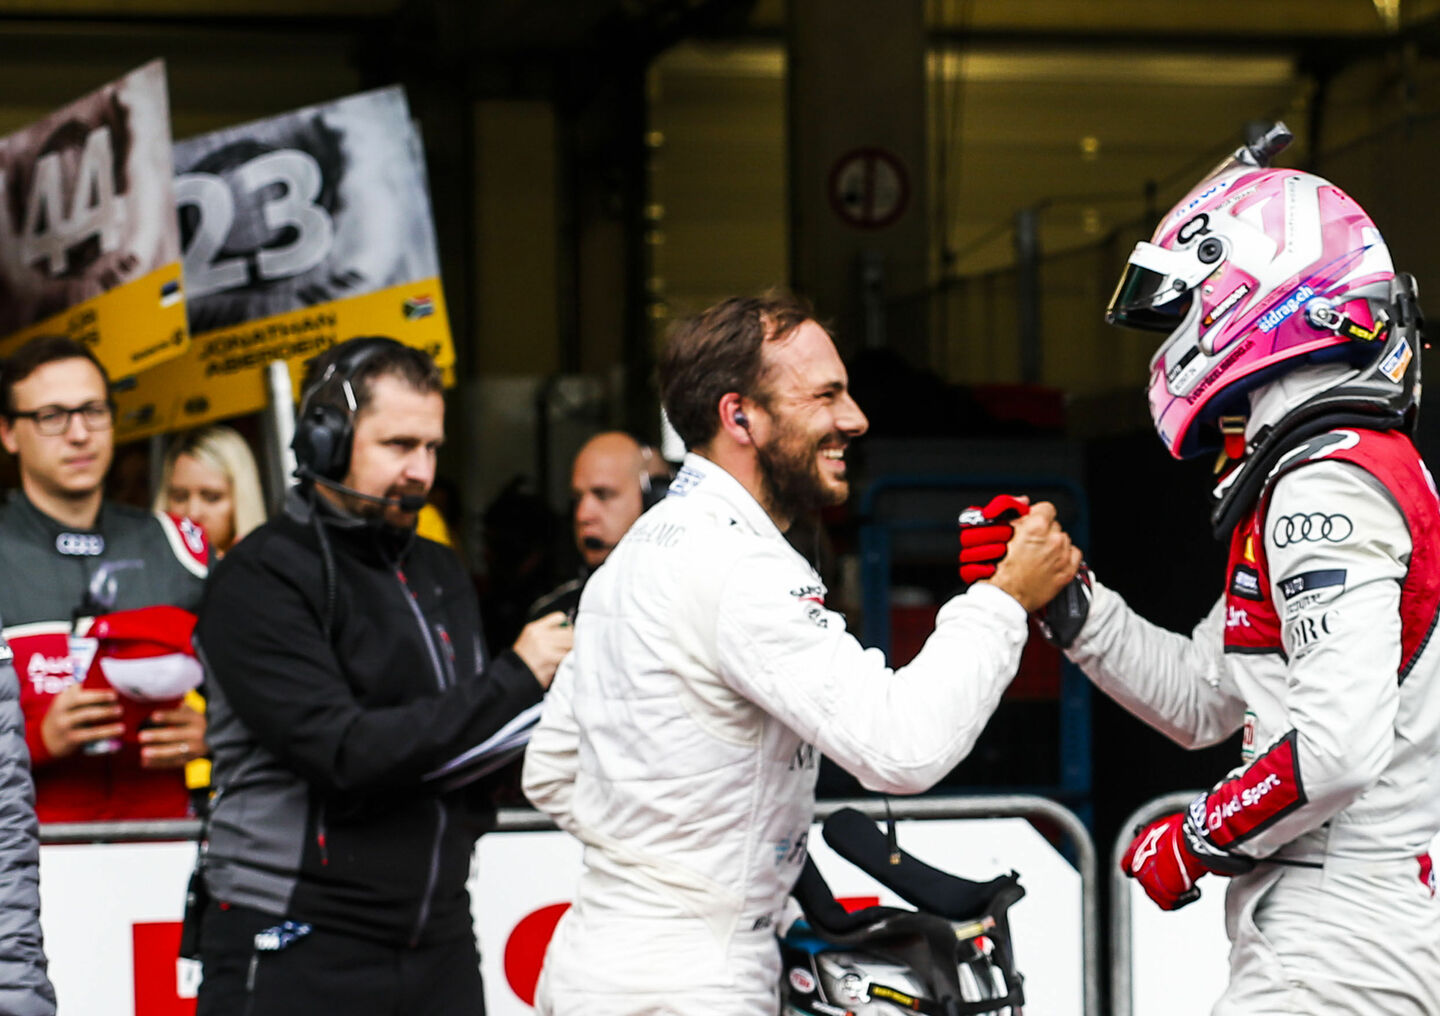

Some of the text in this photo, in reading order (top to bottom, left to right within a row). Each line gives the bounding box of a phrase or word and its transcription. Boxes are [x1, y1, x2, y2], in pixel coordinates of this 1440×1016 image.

[24, 127, 123, 274] 44
[173, 148, 334, 302] 23
[1242, 773, 1281, 806] Sport
